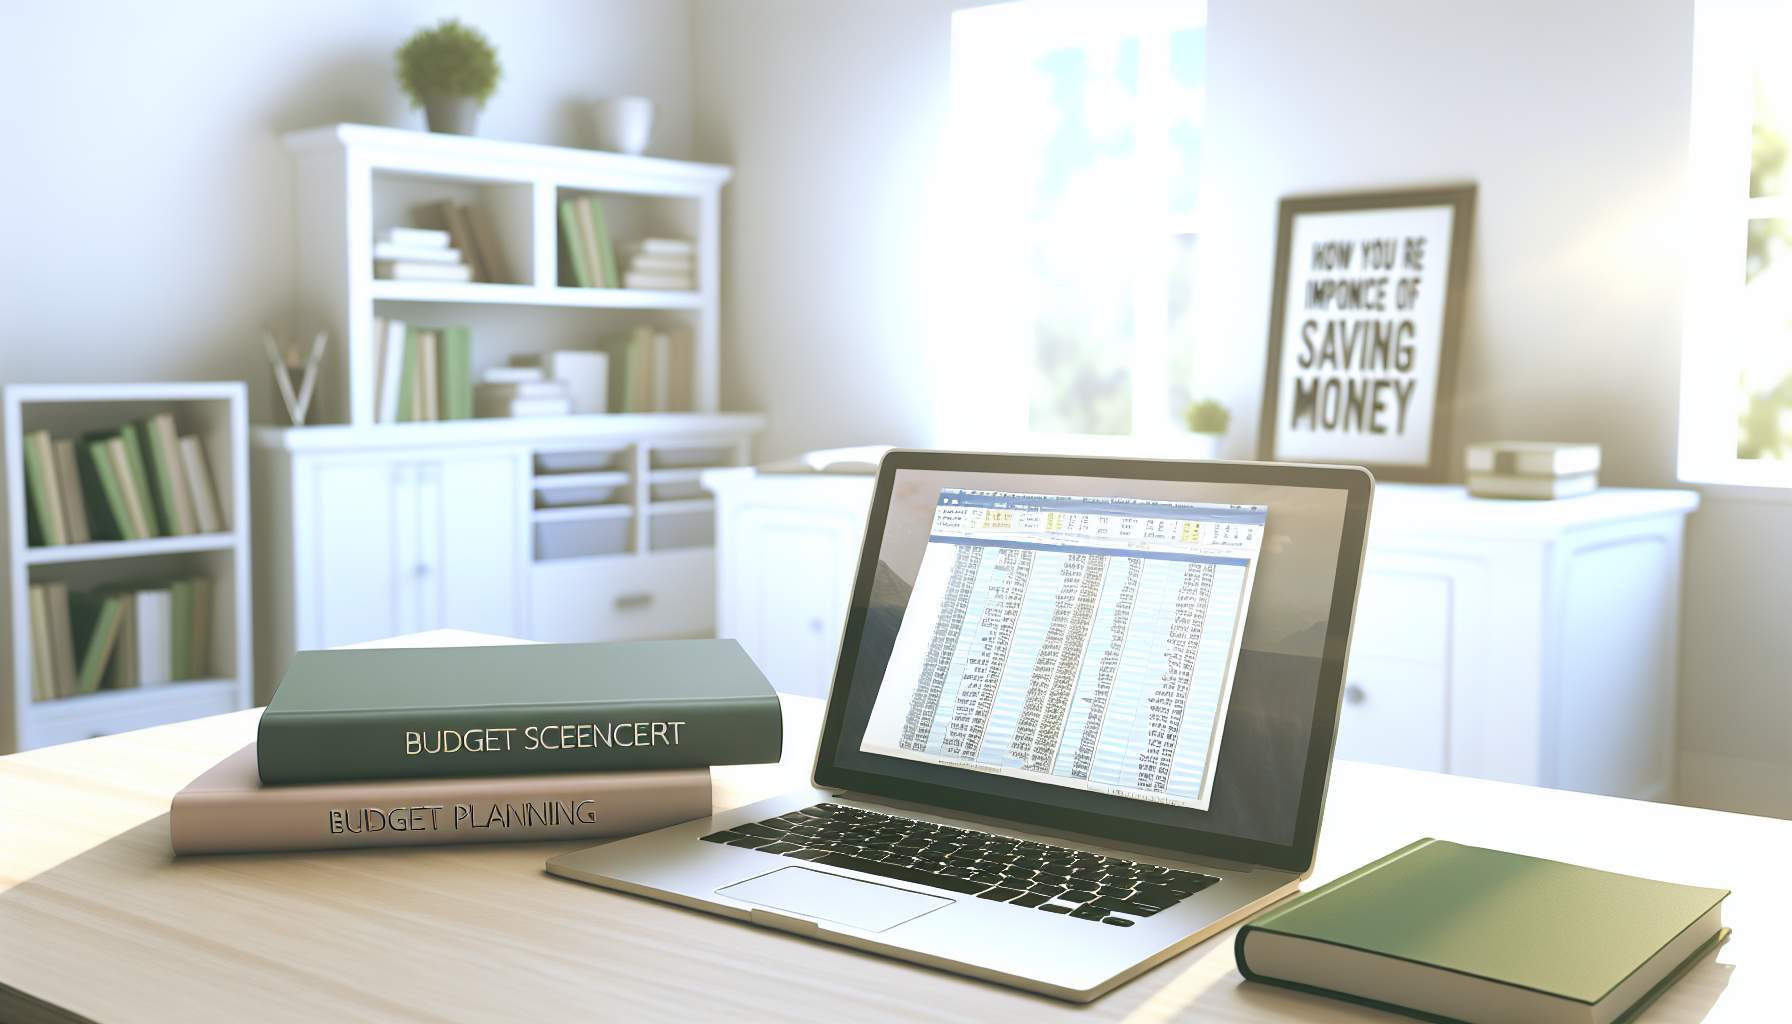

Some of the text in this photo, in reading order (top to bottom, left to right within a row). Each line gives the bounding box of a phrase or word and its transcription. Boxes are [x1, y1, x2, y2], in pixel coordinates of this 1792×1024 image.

[1361, 238, 1397, 270] YOU
[1404, 236, 1427, 271] RE
[1396, 278, 1421, 310] OF
[1298, 319, 1416, 372] SAVING
[1292, 378, 1416, 434] MONEY
[405, 721, 687, 756] BUDGET SCEENCERT
[329, 799, 598, 834] BUDGET PLANNING
